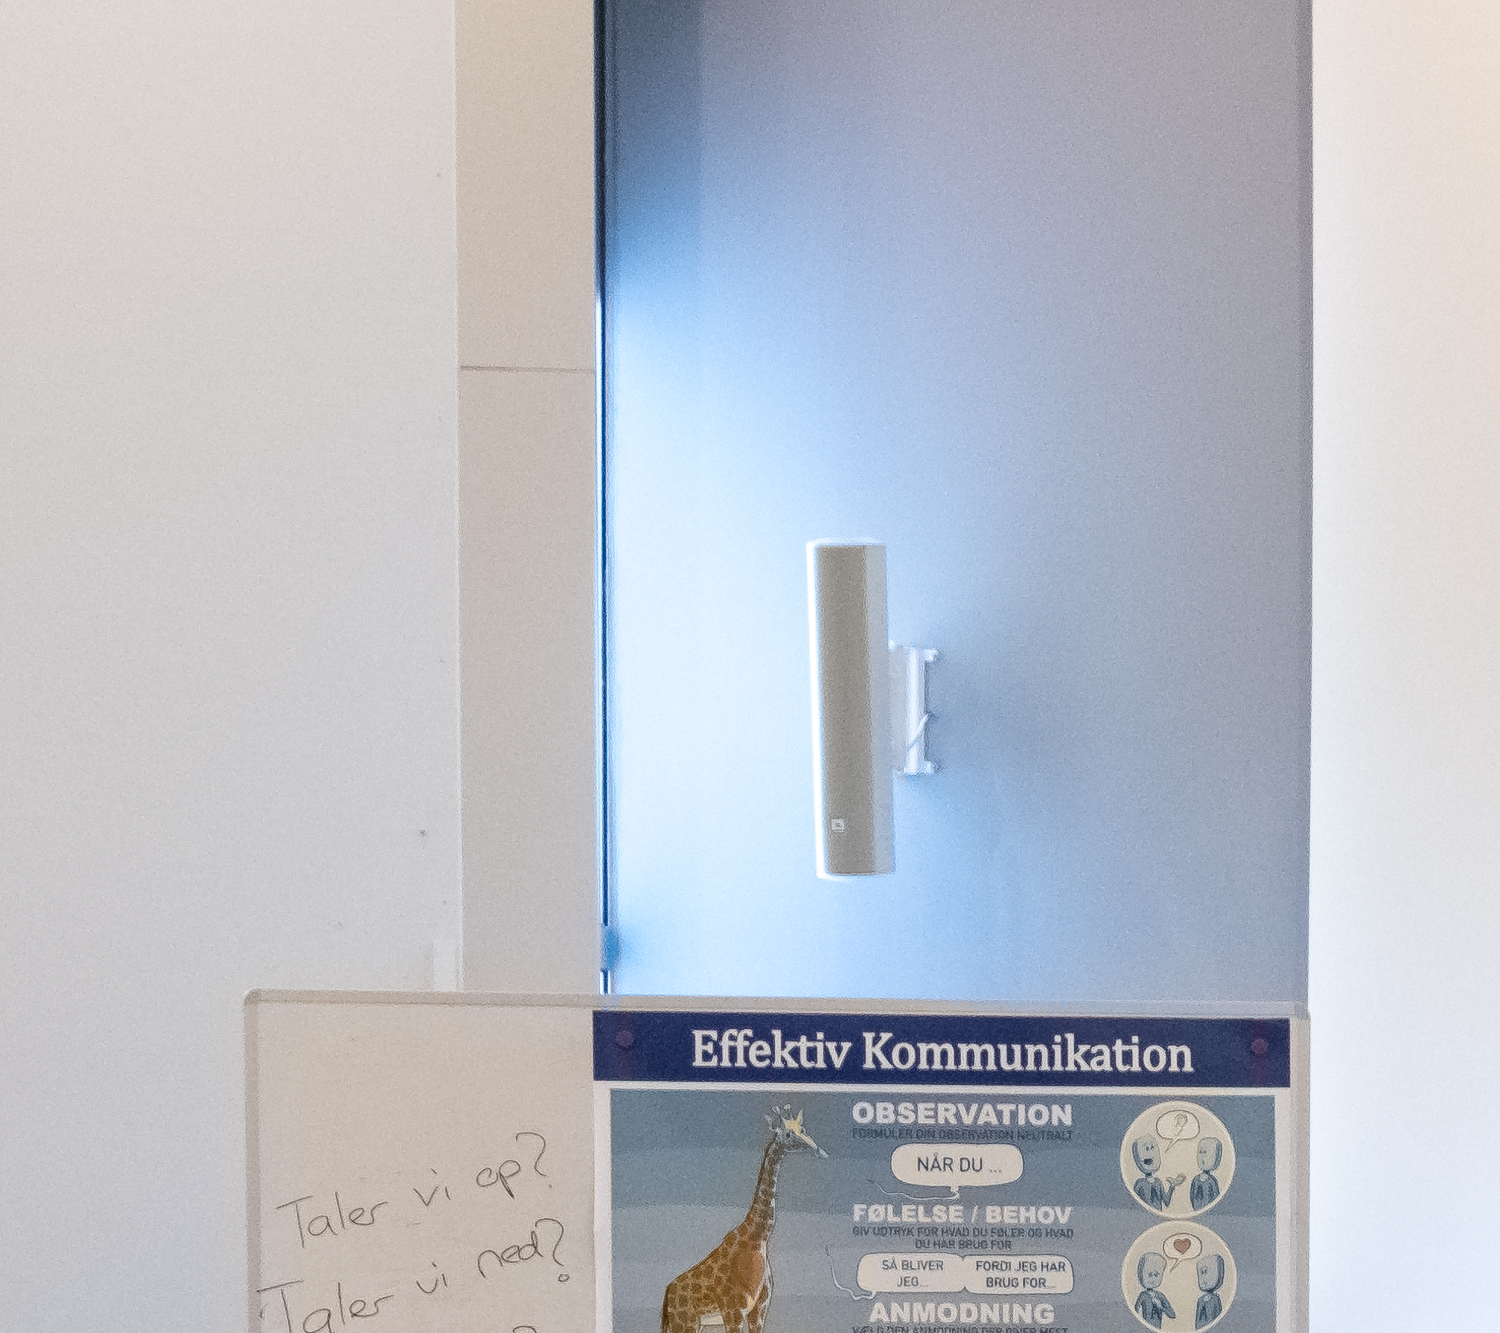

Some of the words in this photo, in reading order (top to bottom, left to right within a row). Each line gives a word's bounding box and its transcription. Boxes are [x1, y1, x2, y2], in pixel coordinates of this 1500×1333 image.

[692, 1029, 852, 1068] Effektiv
[863, 1032, 1194, 1072] Kommunikation
[852, 1102, 1073, 1126] OBSERVATION
[917, 1153, 953, 1173] NÅR
[960, 1157, 983, 1173] DU
[276, 1192, 388, 1248] Taler
[413, 1168, 452, 1207] vi
[476, 1131, 553, 1198] op?
[853, 1204, 964, 1224] FØLELSE
[986, 1206, 1073, 1225] BEHOV
[917, 1227, 938, 1237] FOR
[941, 1227, 969, 1237] HVAD
[973, 1227, 987, 1237] DU
[1027, 1228, 1042, 1238] OG
[1045, 1228, 1073, 1239] HVAD
[915, 1239, 930, 1249] DU
[933, 1239, 955, 1249] HAR
[959, 1239, 987, 1250] BRUG
[991, 1240, 1012, 1250] FOR
[416, 1262, 448, 1294] vi
[477, 1217, 570, 1283] ned?
[882, 1258, 897, 1270] SÅ
[902, 1260, 944, 1271] BLIVER
[976, 1261, 1011, 1271] FORDI
[1016, 1261, 1037, 1272] JEG
[1041, 1262, 1066, 1272] HAR
[986, 1277, 1019, 1288] BRUG
[869, 1302, 1055, 1324] ANMODNING
